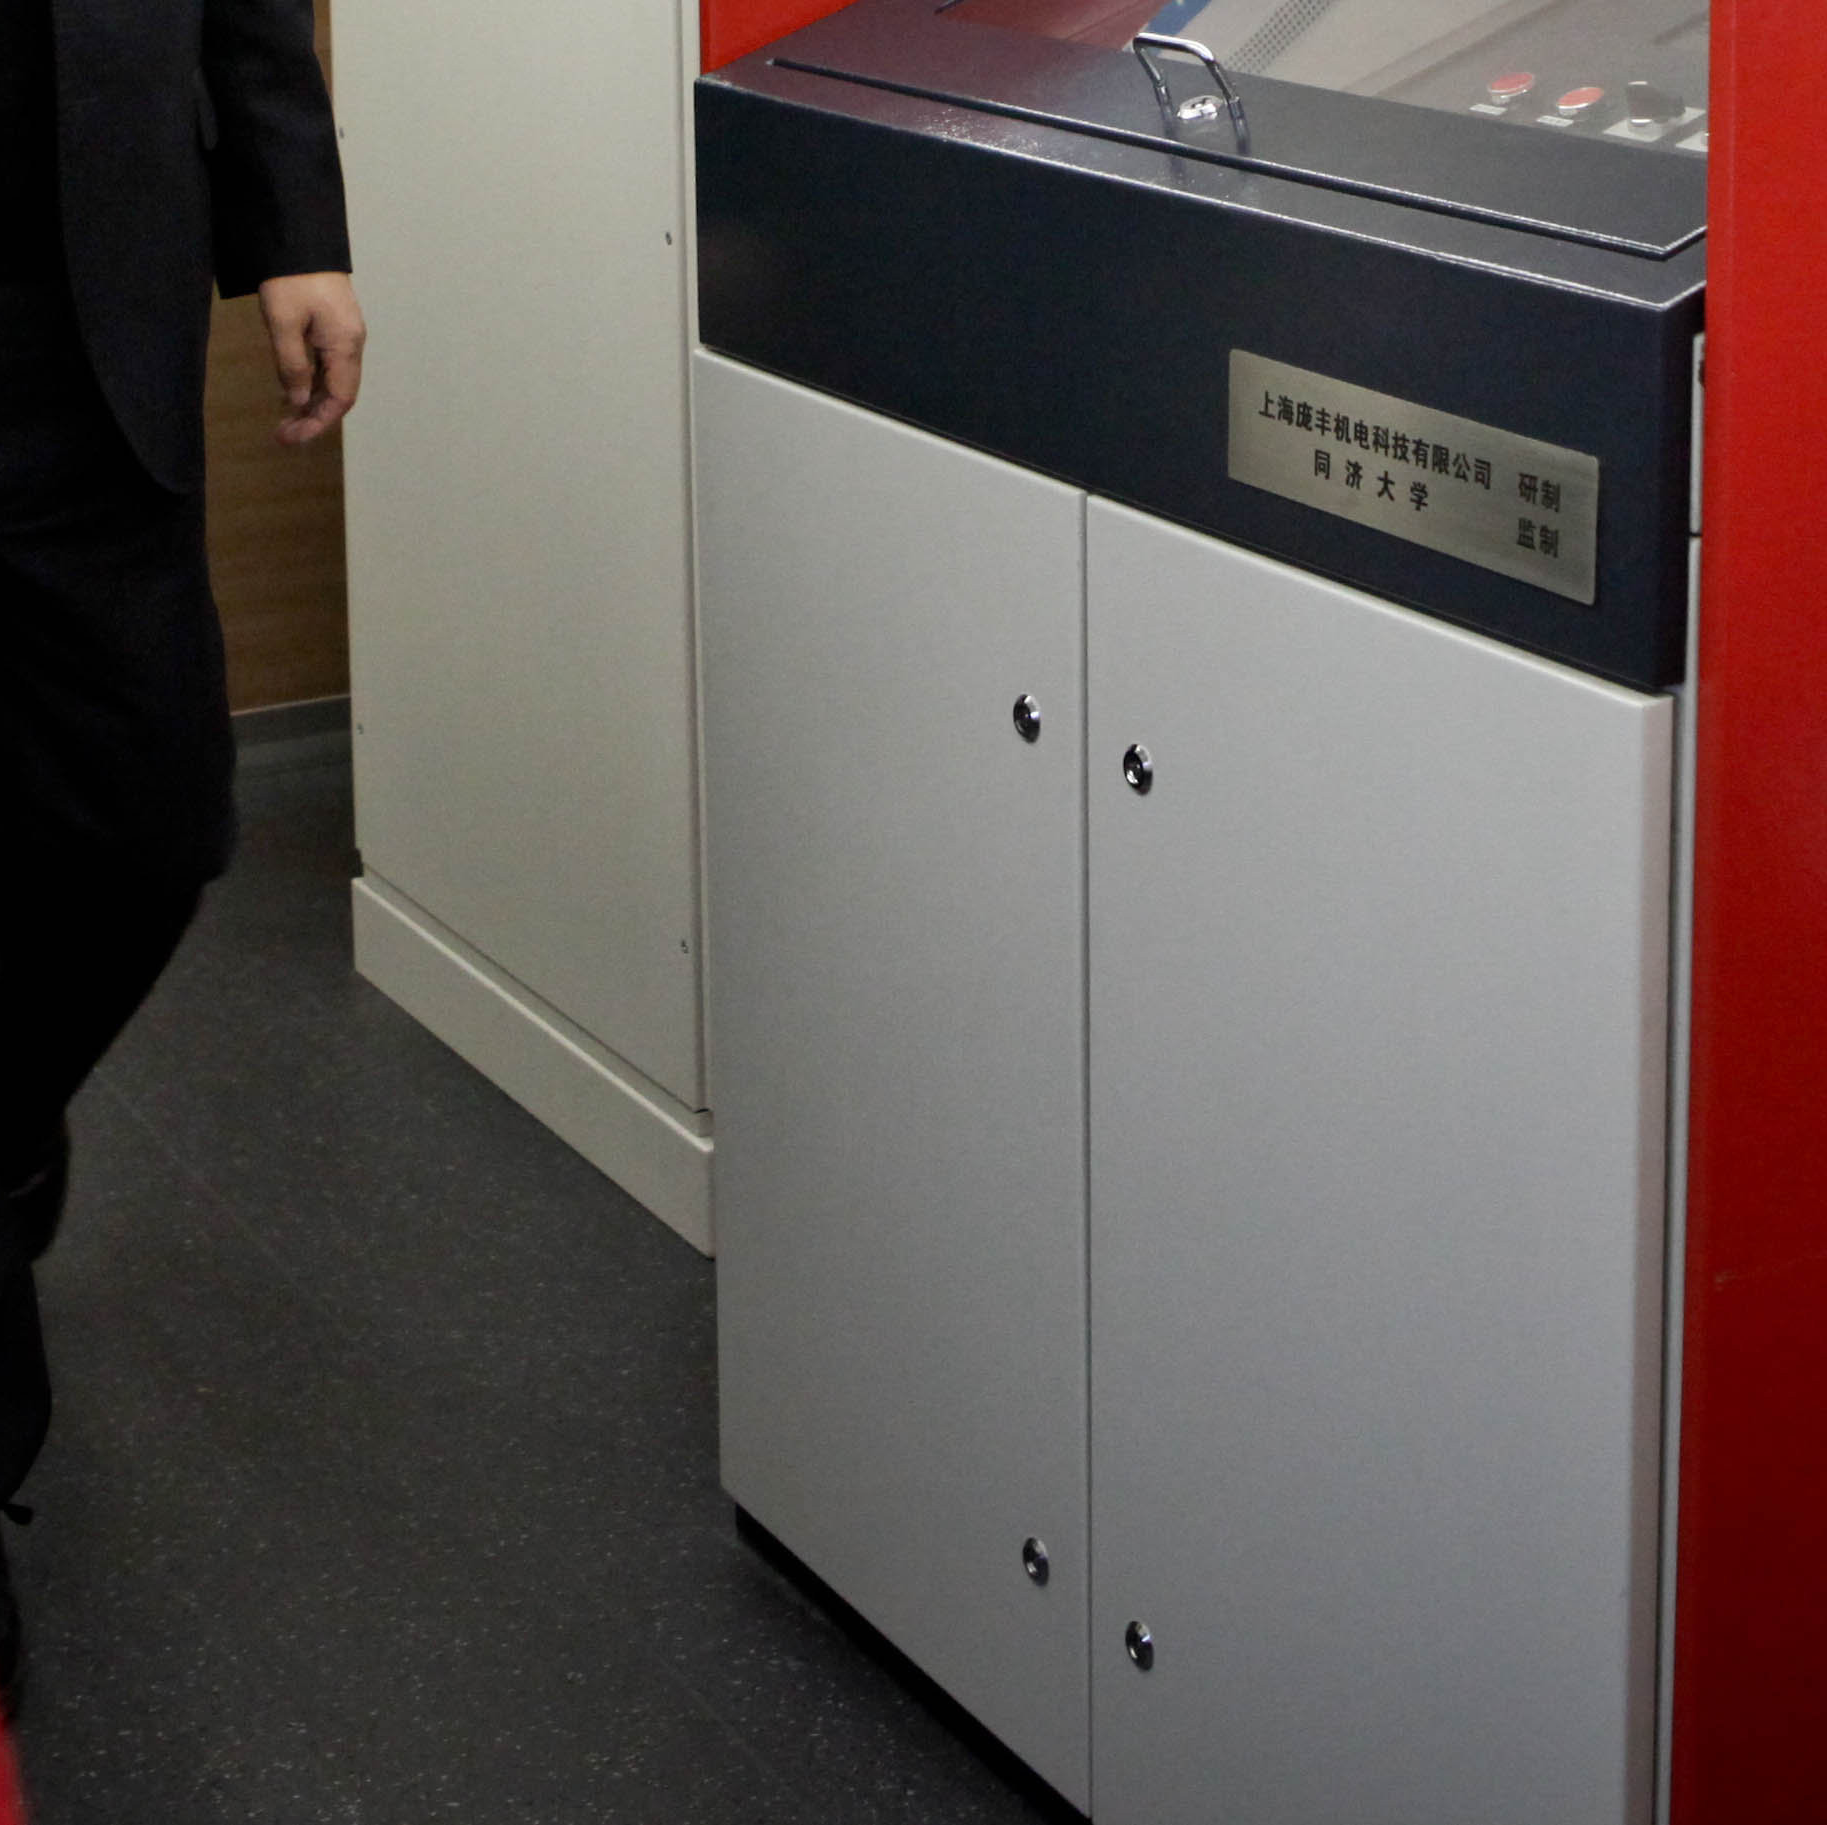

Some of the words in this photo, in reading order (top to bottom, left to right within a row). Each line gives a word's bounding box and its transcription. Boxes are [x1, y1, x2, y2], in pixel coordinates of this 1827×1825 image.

[1259, 390, 1492, 490] 上海庞丰机电科技有限公司
[1518, 472, 1561, 513] 研制
[1313, 448, 1429, 511] 同济大学
[1516, 517, 1559, 558] 监制
